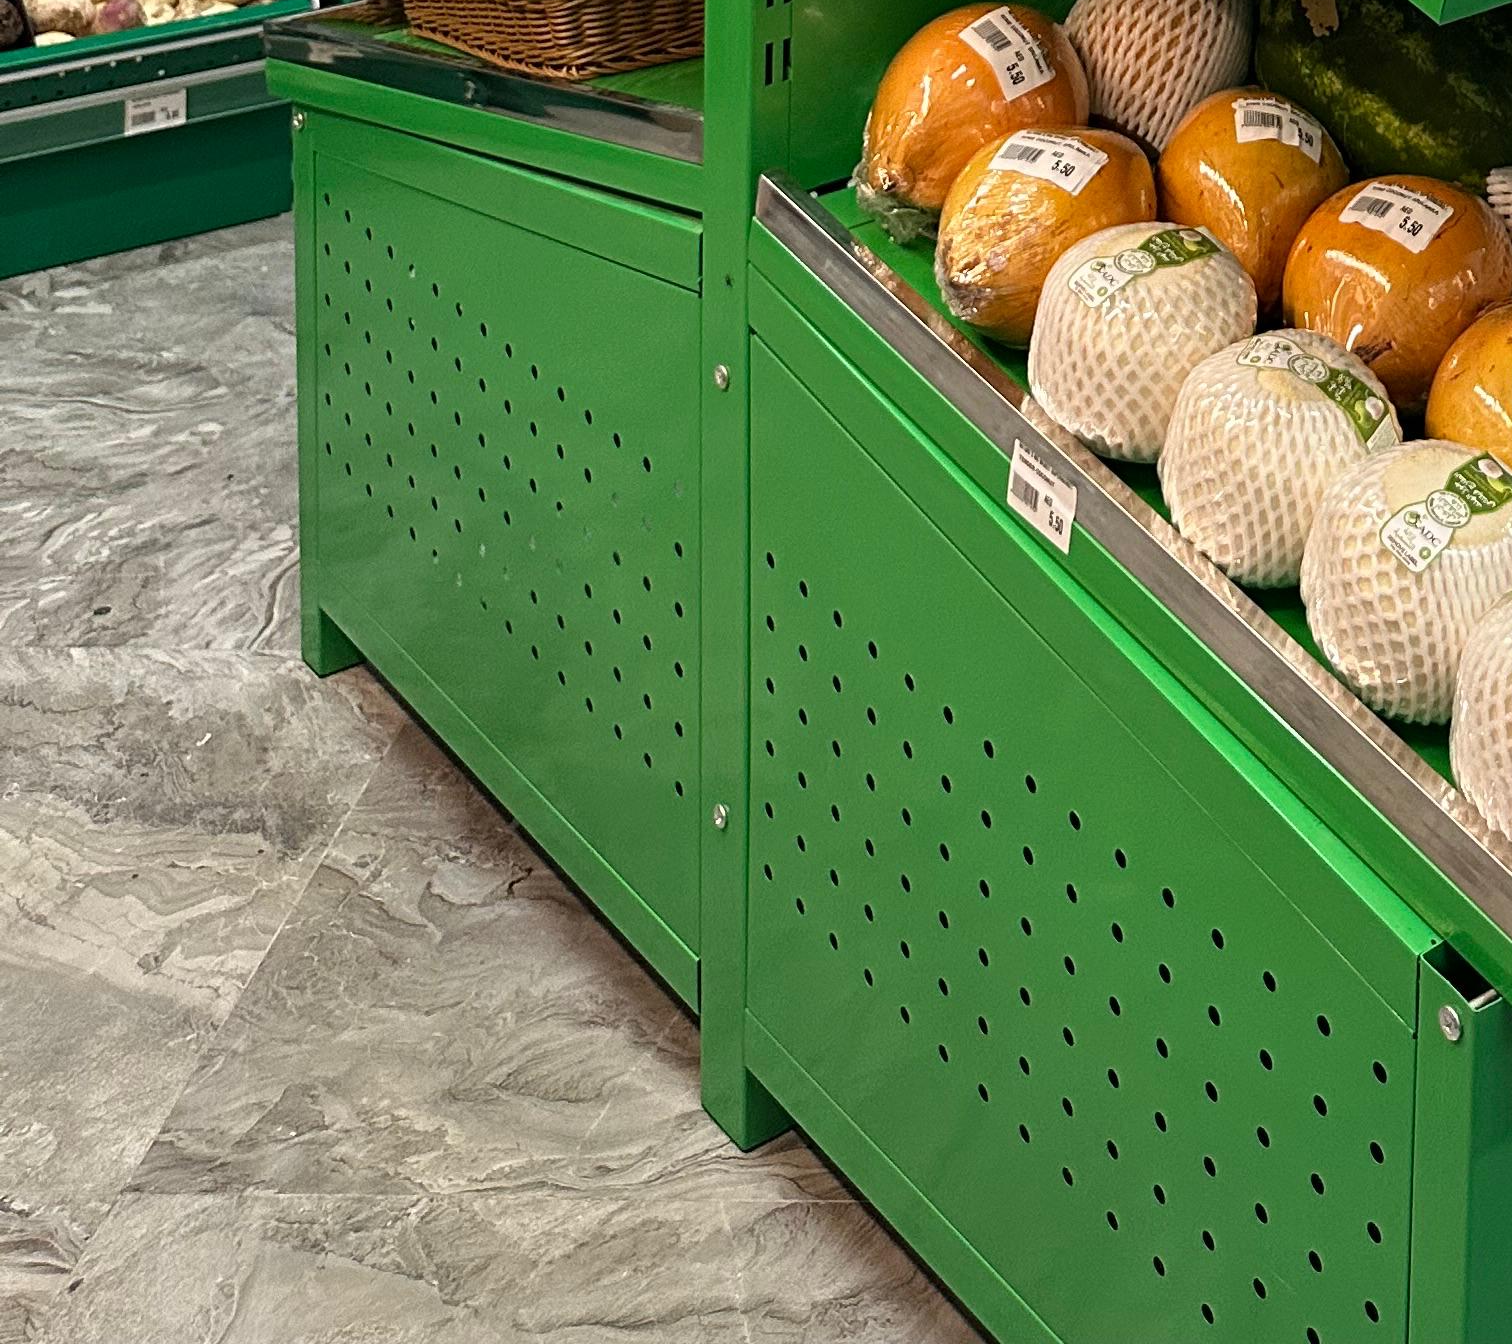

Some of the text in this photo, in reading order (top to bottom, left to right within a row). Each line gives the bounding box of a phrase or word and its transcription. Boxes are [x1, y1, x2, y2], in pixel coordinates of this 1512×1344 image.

[1006, 62, 1026, 85] 5.50
[1051, 160, 1076, 177] 5.50
[1399, 216, 1424, 237] 5.50
[1048, 511, 1064, 535] 5.50
